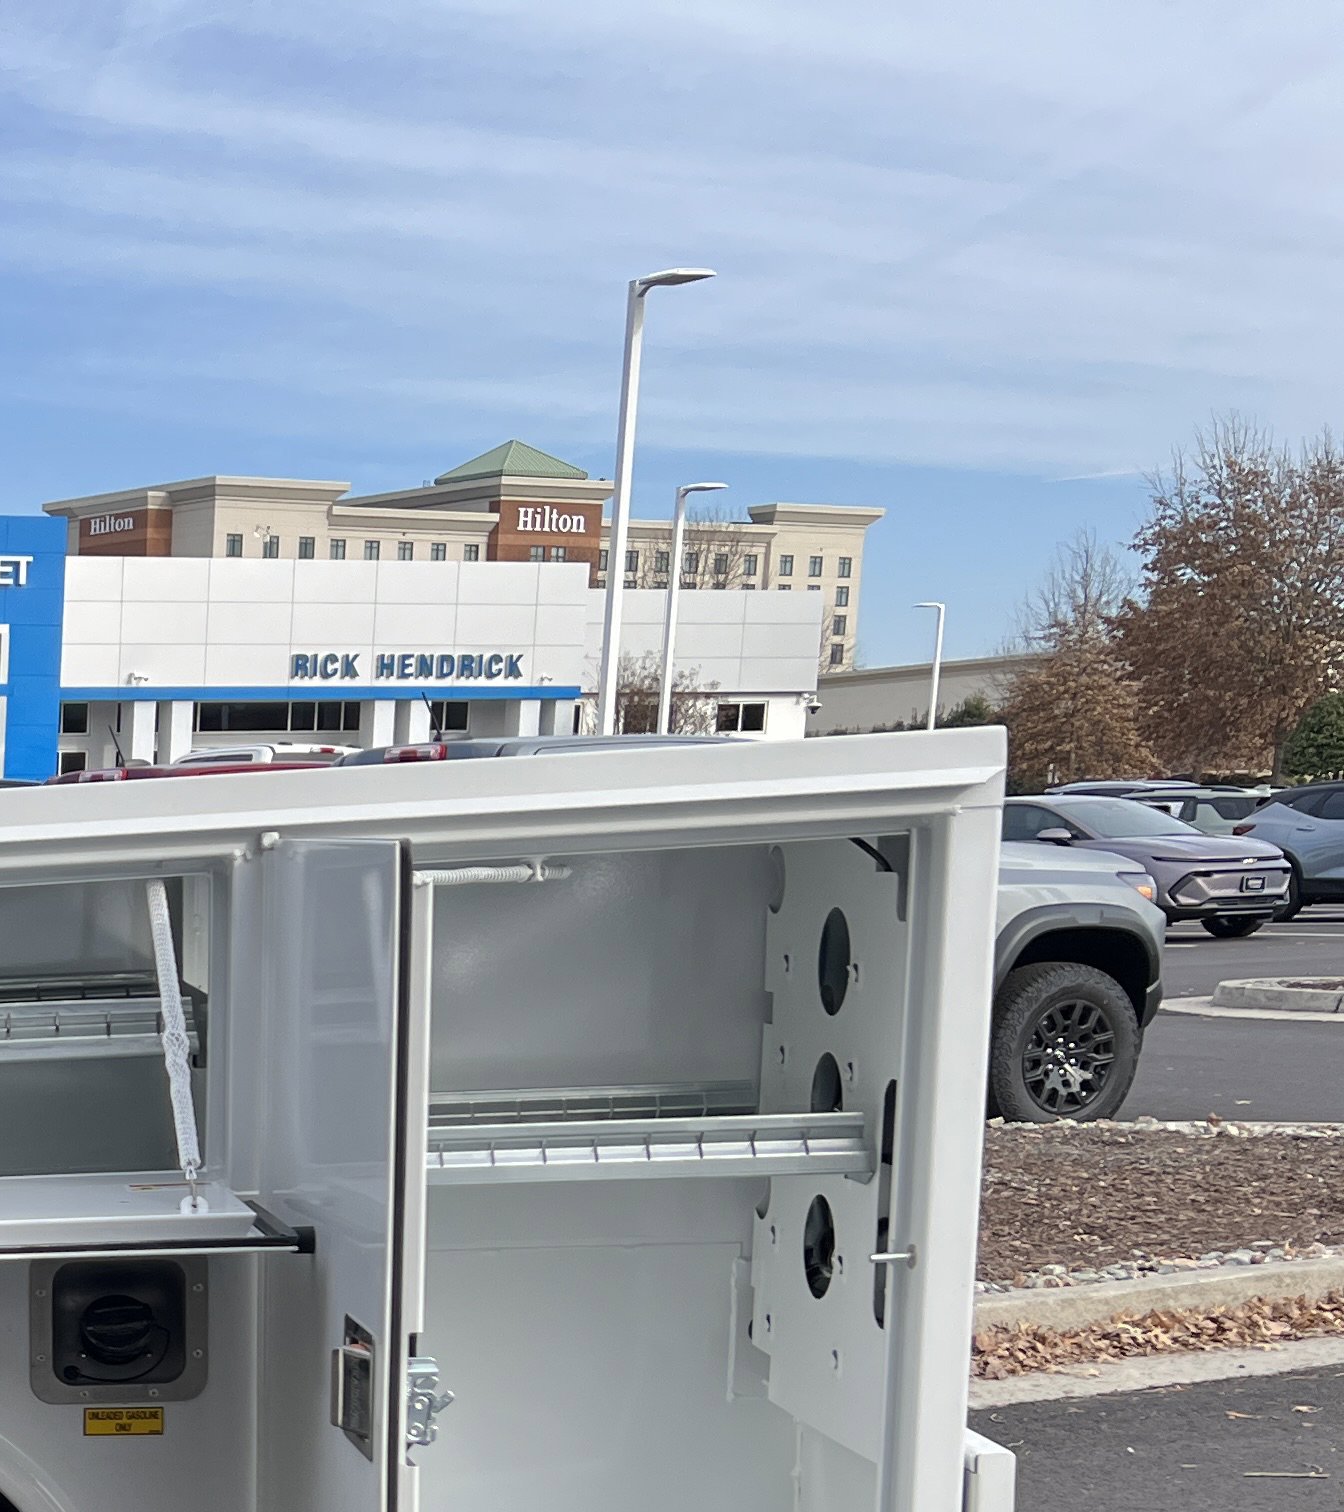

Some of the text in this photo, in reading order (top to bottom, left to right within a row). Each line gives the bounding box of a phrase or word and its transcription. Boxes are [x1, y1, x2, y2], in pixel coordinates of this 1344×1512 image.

[90, 515, 133, 535] Hilton
[517, 506, 585, 533] Hilton
[291, 653, 523, 679] RICK HENDRICK
[114, 1423, 132, 1432] ONLY
